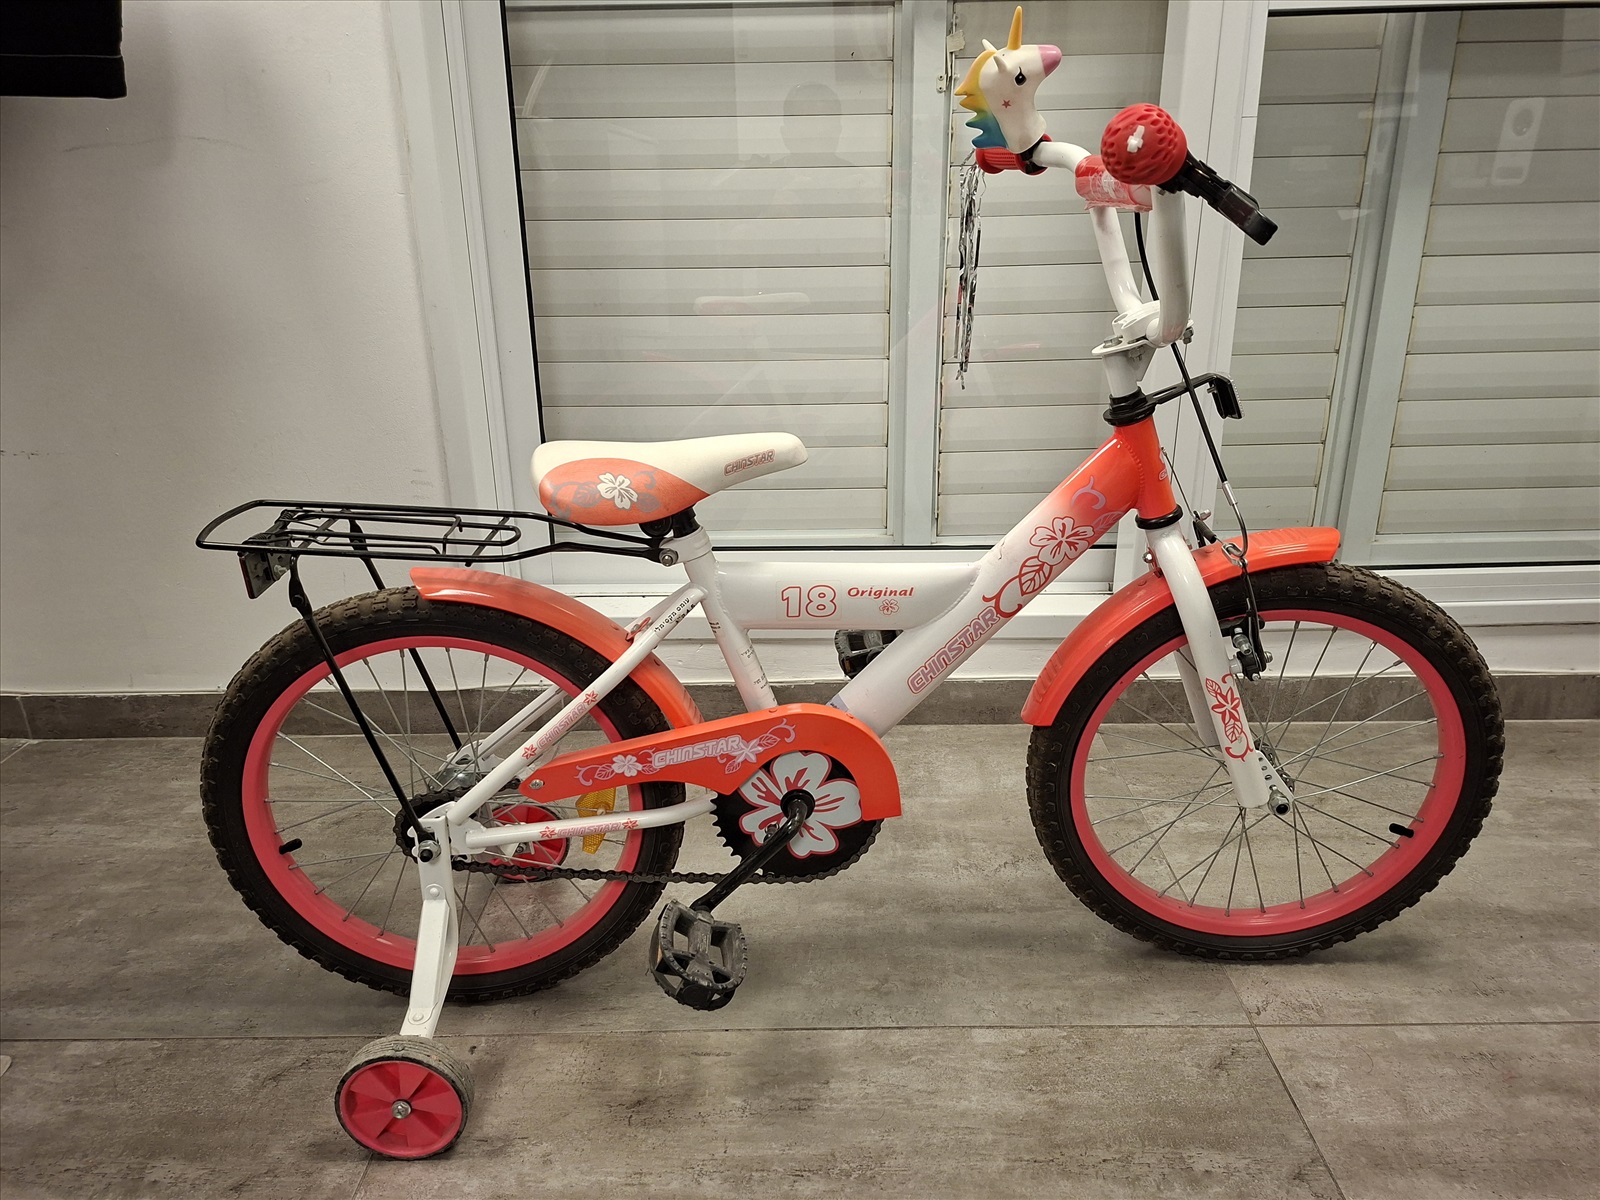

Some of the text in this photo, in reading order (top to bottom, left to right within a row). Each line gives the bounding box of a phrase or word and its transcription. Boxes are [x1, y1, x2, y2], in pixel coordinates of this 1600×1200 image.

[724, 449, 775, 476] CHINSTAR
[781, 585, 837, 618] 18
[847, 587, 914, 599] Original
[653, 597, 690, 633] עומס מקסימלי
[907, 606, 1000, 694] CHINSTAR
[537, 702, 588, 750] CHINSTAR
[652, 734, 743, 769] CHINSTAR
[556, 821, 622, 837] CHINSTAR
